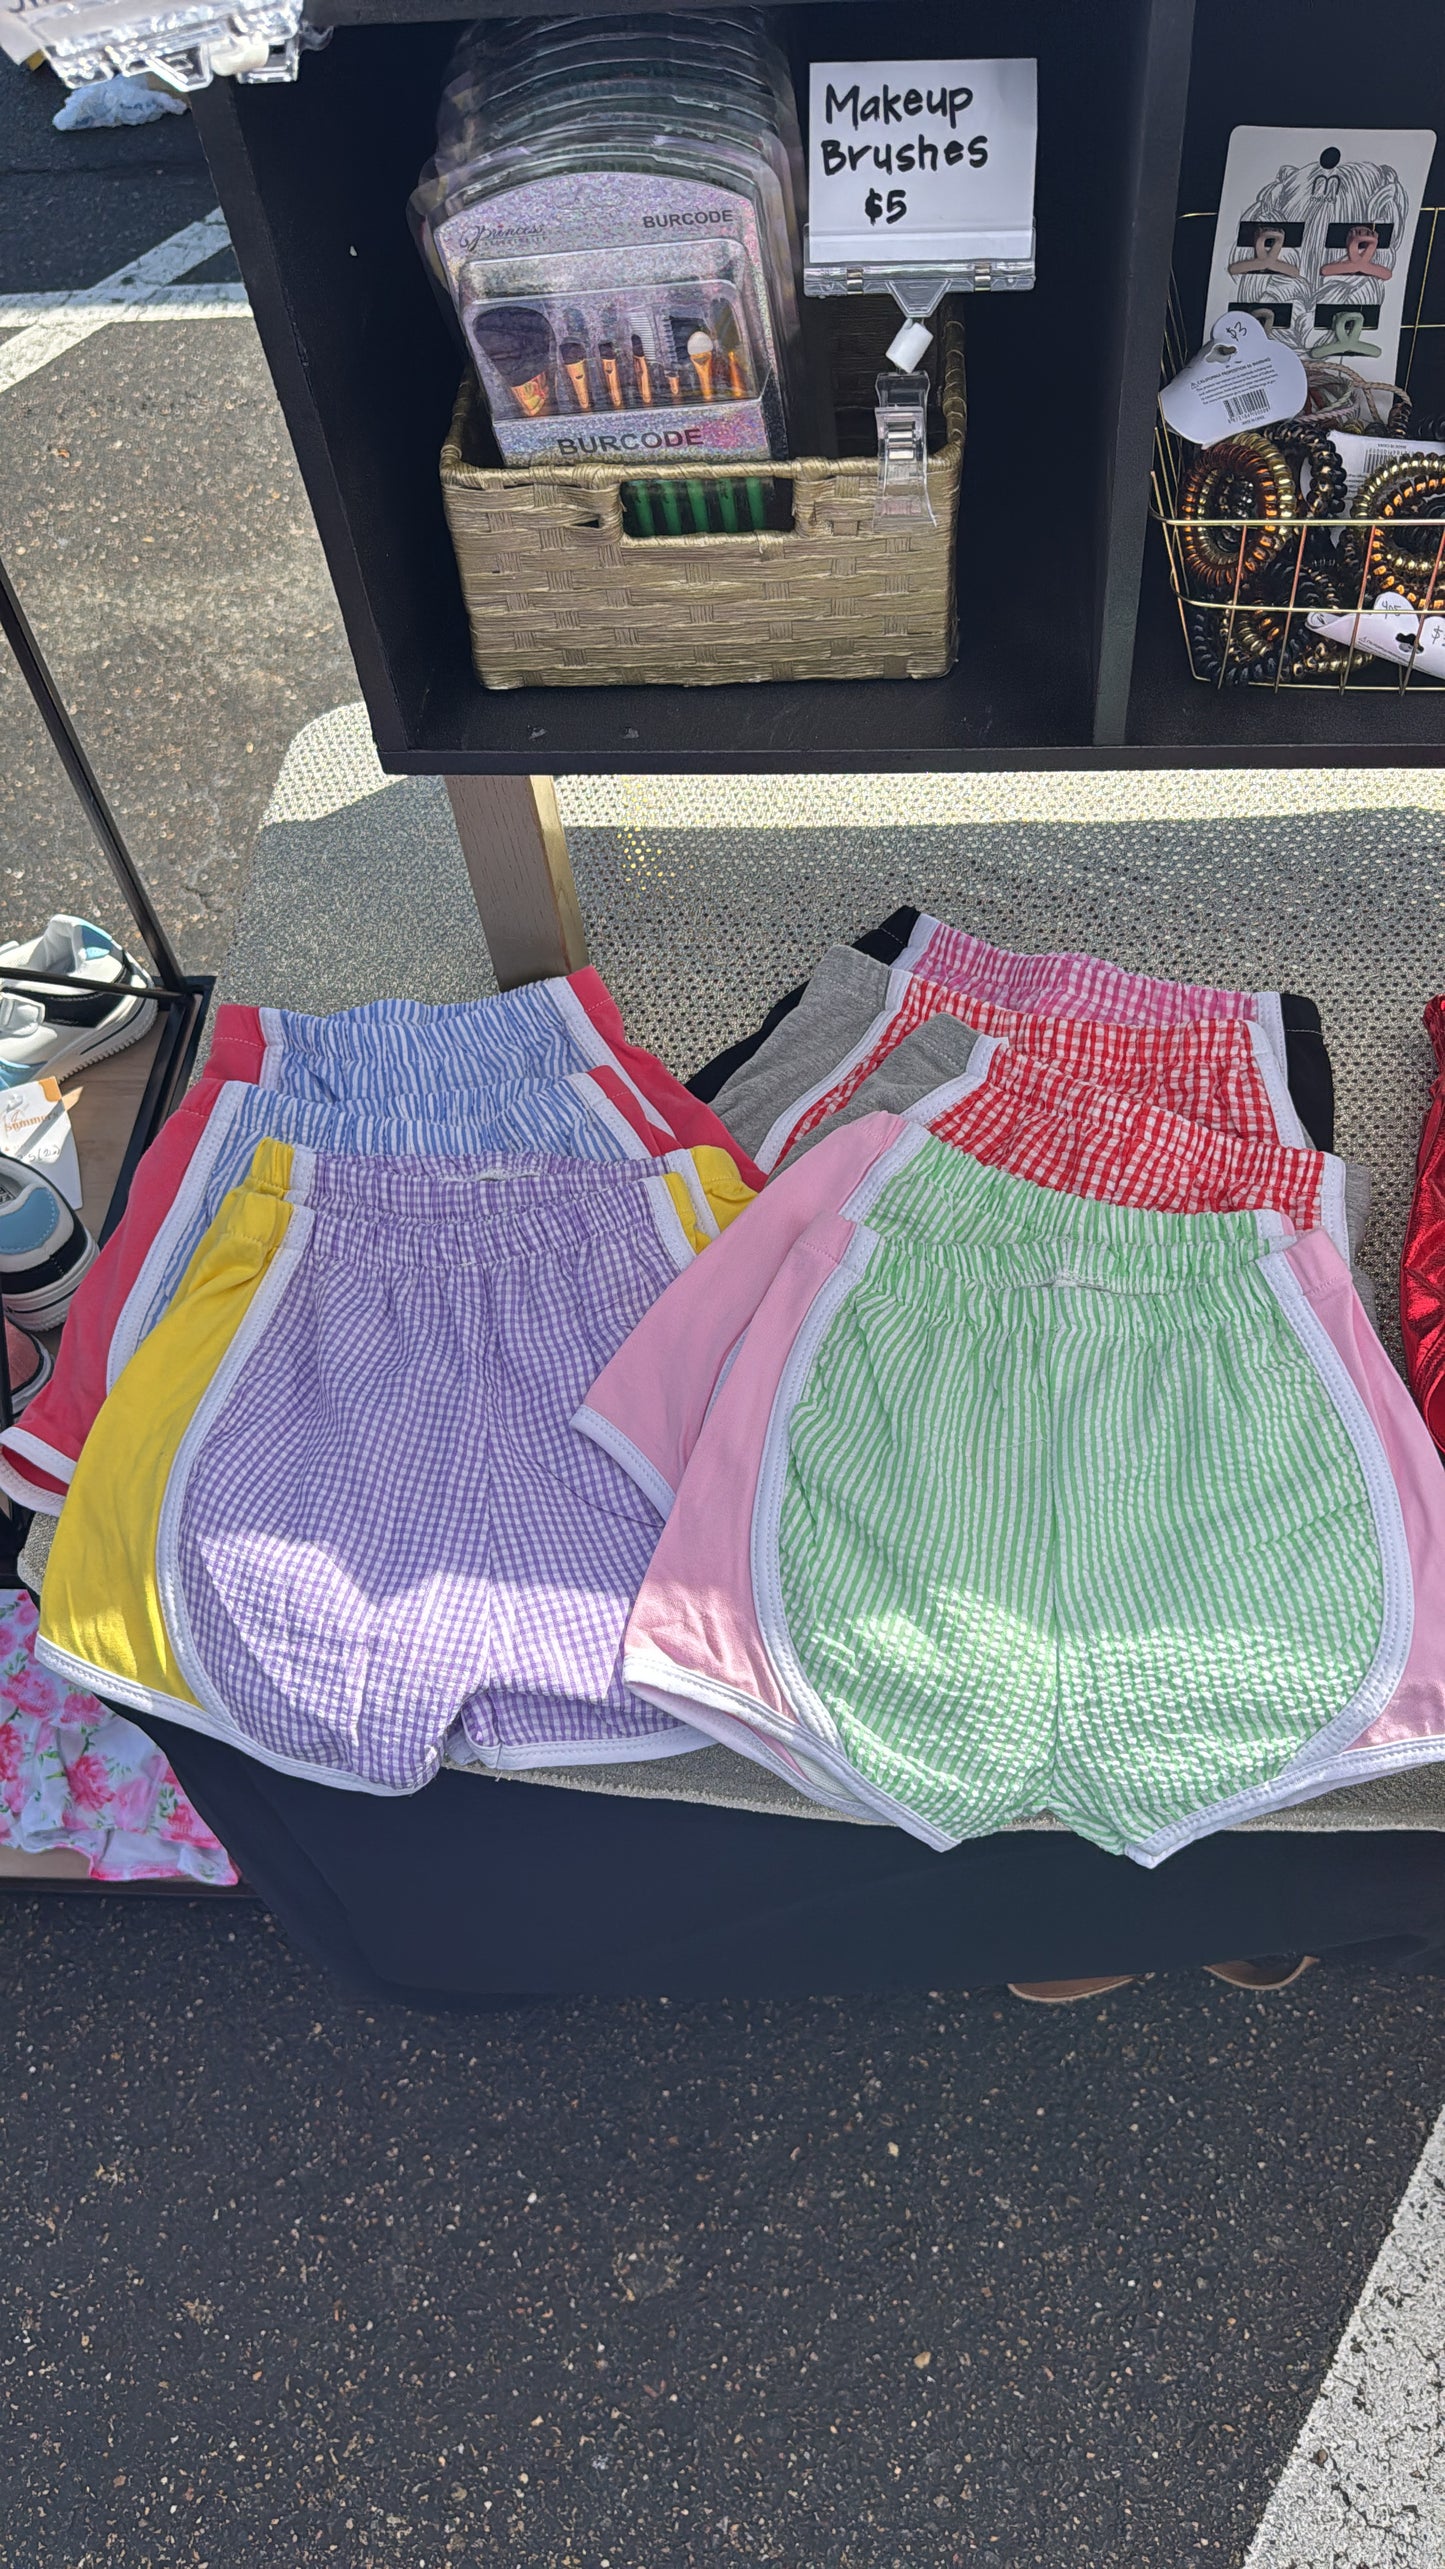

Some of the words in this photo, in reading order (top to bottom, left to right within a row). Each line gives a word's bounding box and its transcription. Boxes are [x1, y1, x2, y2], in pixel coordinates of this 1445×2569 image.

[825, 83, 973, 130] Makeup
[820, 134, 989, 176] Brushes
[643, 209, 734, 229] BURCODE
[864, 187, 907, 226] $5
[460, 224, 545, 251] Princess
[1225, 321, 1248, 341] $3
[557, 428, 704, 455] BURCODE
